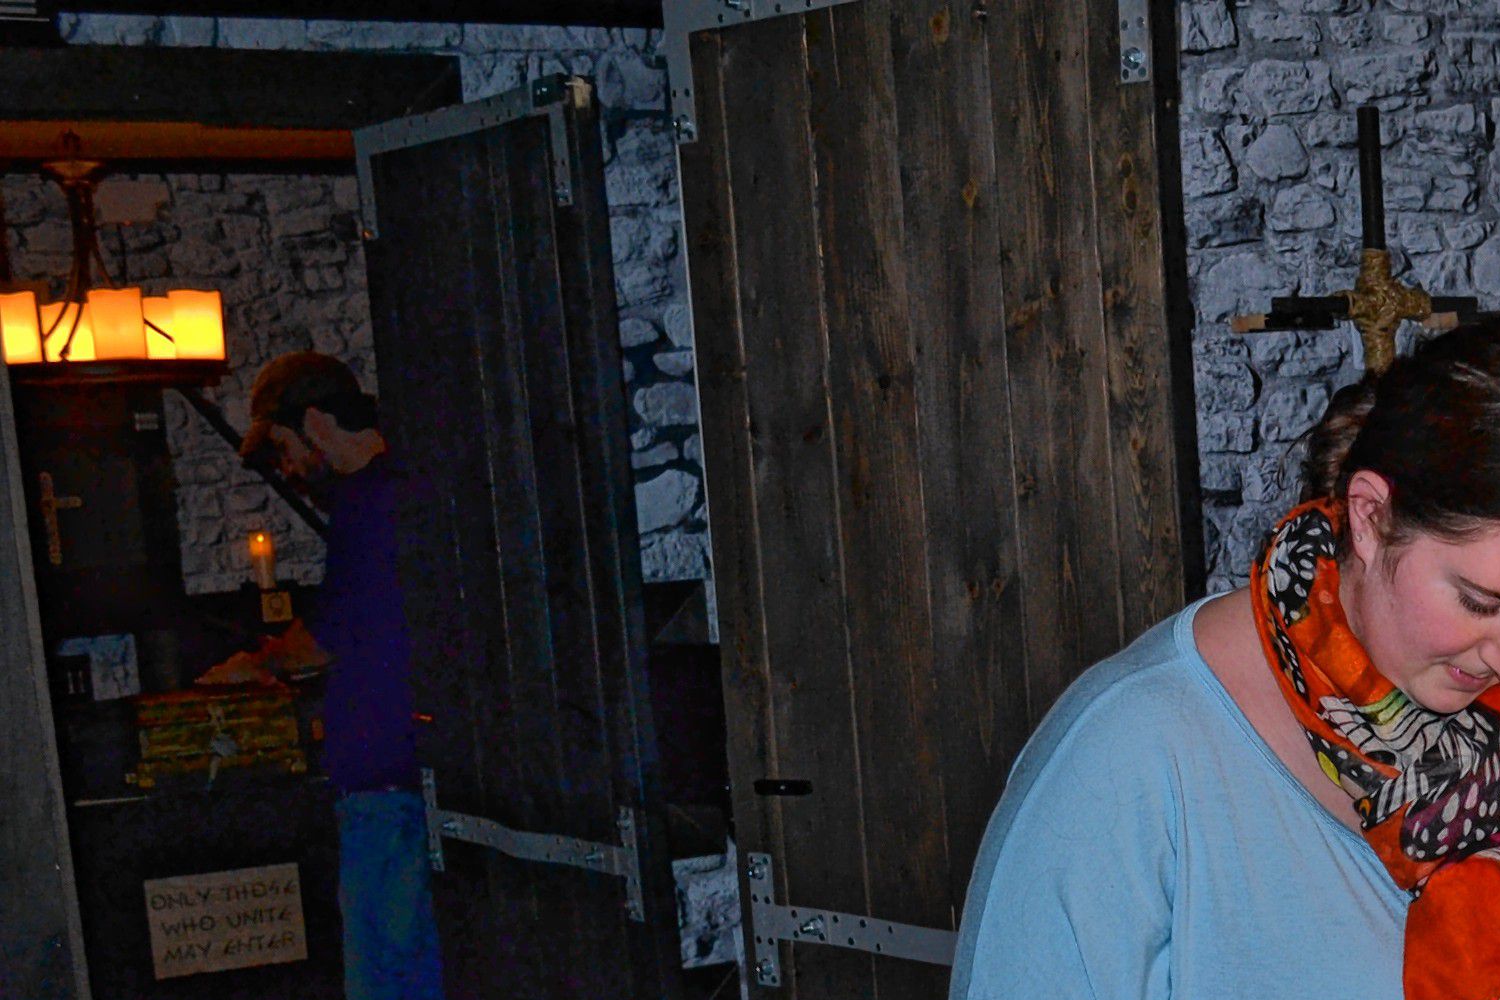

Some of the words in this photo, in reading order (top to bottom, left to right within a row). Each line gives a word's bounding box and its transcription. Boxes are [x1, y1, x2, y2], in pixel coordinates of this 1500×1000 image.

[150, 891, 212, 912] ONLY
[220, 879, 298, 903] THOSE
[161, 916, 217, 937] WHO
[225, 905, 293, 930] UNITE
[163, 941, 213, 964] MAY
[223, 930, 296, 956] ENTER
